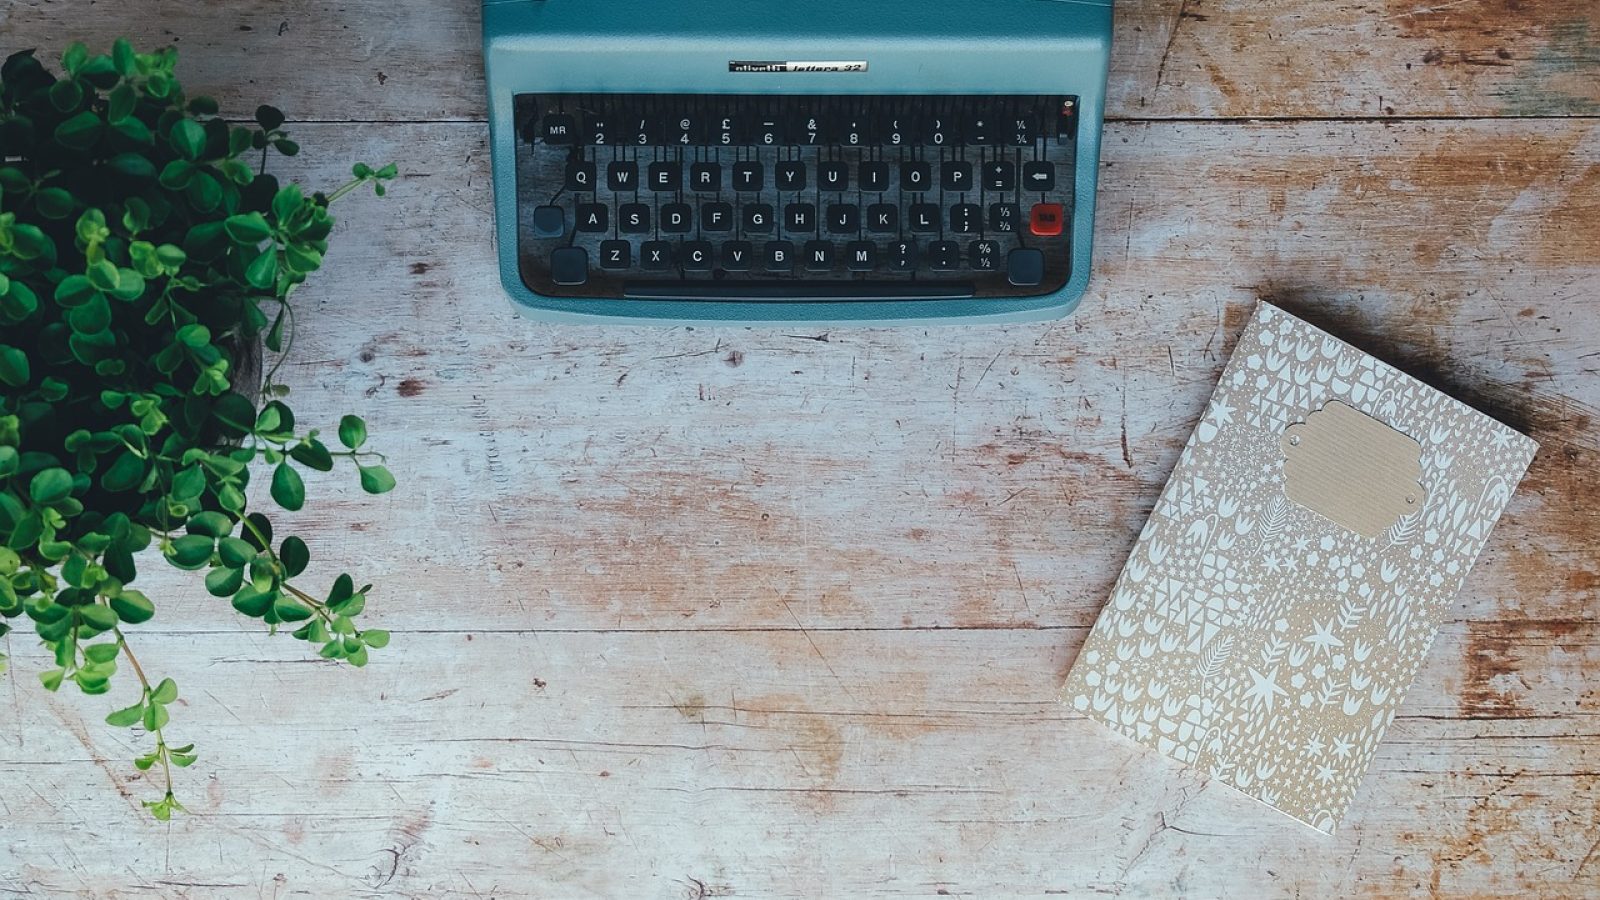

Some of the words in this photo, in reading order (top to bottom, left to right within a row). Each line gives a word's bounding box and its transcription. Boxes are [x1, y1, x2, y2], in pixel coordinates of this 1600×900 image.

[735, 64, 781, 72] olivetti
[793, 64, 839, 72] lettera
[844, 64, 862, 72] 32
[549, 125, 566, 135] MR
[679, 118, 691, 130] @
[721, 118, 731, 130] £
[807, 117, 817, 130] &
[595, 133, 605, 145] 2
[638, 133, 648, 145] 3
[679, 132, 690, 145] 4
[721, 132, 731, 145] 5
[763, 132, 773, 145] 6
[807, 132, 816, 145] 7
[849, 132, 859, 145] 8
[891, 132, 902, 145] 9
[575, 170, 587, 185] Q
[616, 171, 629, 183] W
[658, 171, 669, 183] E
[700, 171, 711, 183] R
[742, 171, 753, 183] T
[785, 170, 795, 183] Y
[827, 171, 838, 183] U
[910, 171, 921, 183] O
[952, 171, 963, 183] P
[587, 212, 599, 225] A
[629, 212, 640, 225] S
[671, 212, 682, 225] D
[712, 211, 722, 224] F
[752, 212, 764, 225] G
[794, 212, 805, 225] H
[838, 212, 847, 225] J
[878, 212, 889, 225] K
[919, 212, 930, 225] L
[898, 243, 907, 255] ?
[978, 242, 991, 255] %
[610, 249, 621, 261] Z
[650, 249, 661, 262] X
[691, 249, 702, 262] C
[732, 249, 743, 262] V
[774, 250, 785, 262] B
[814, 249, 825, 262] N
[856, 249, 868, 262] M
